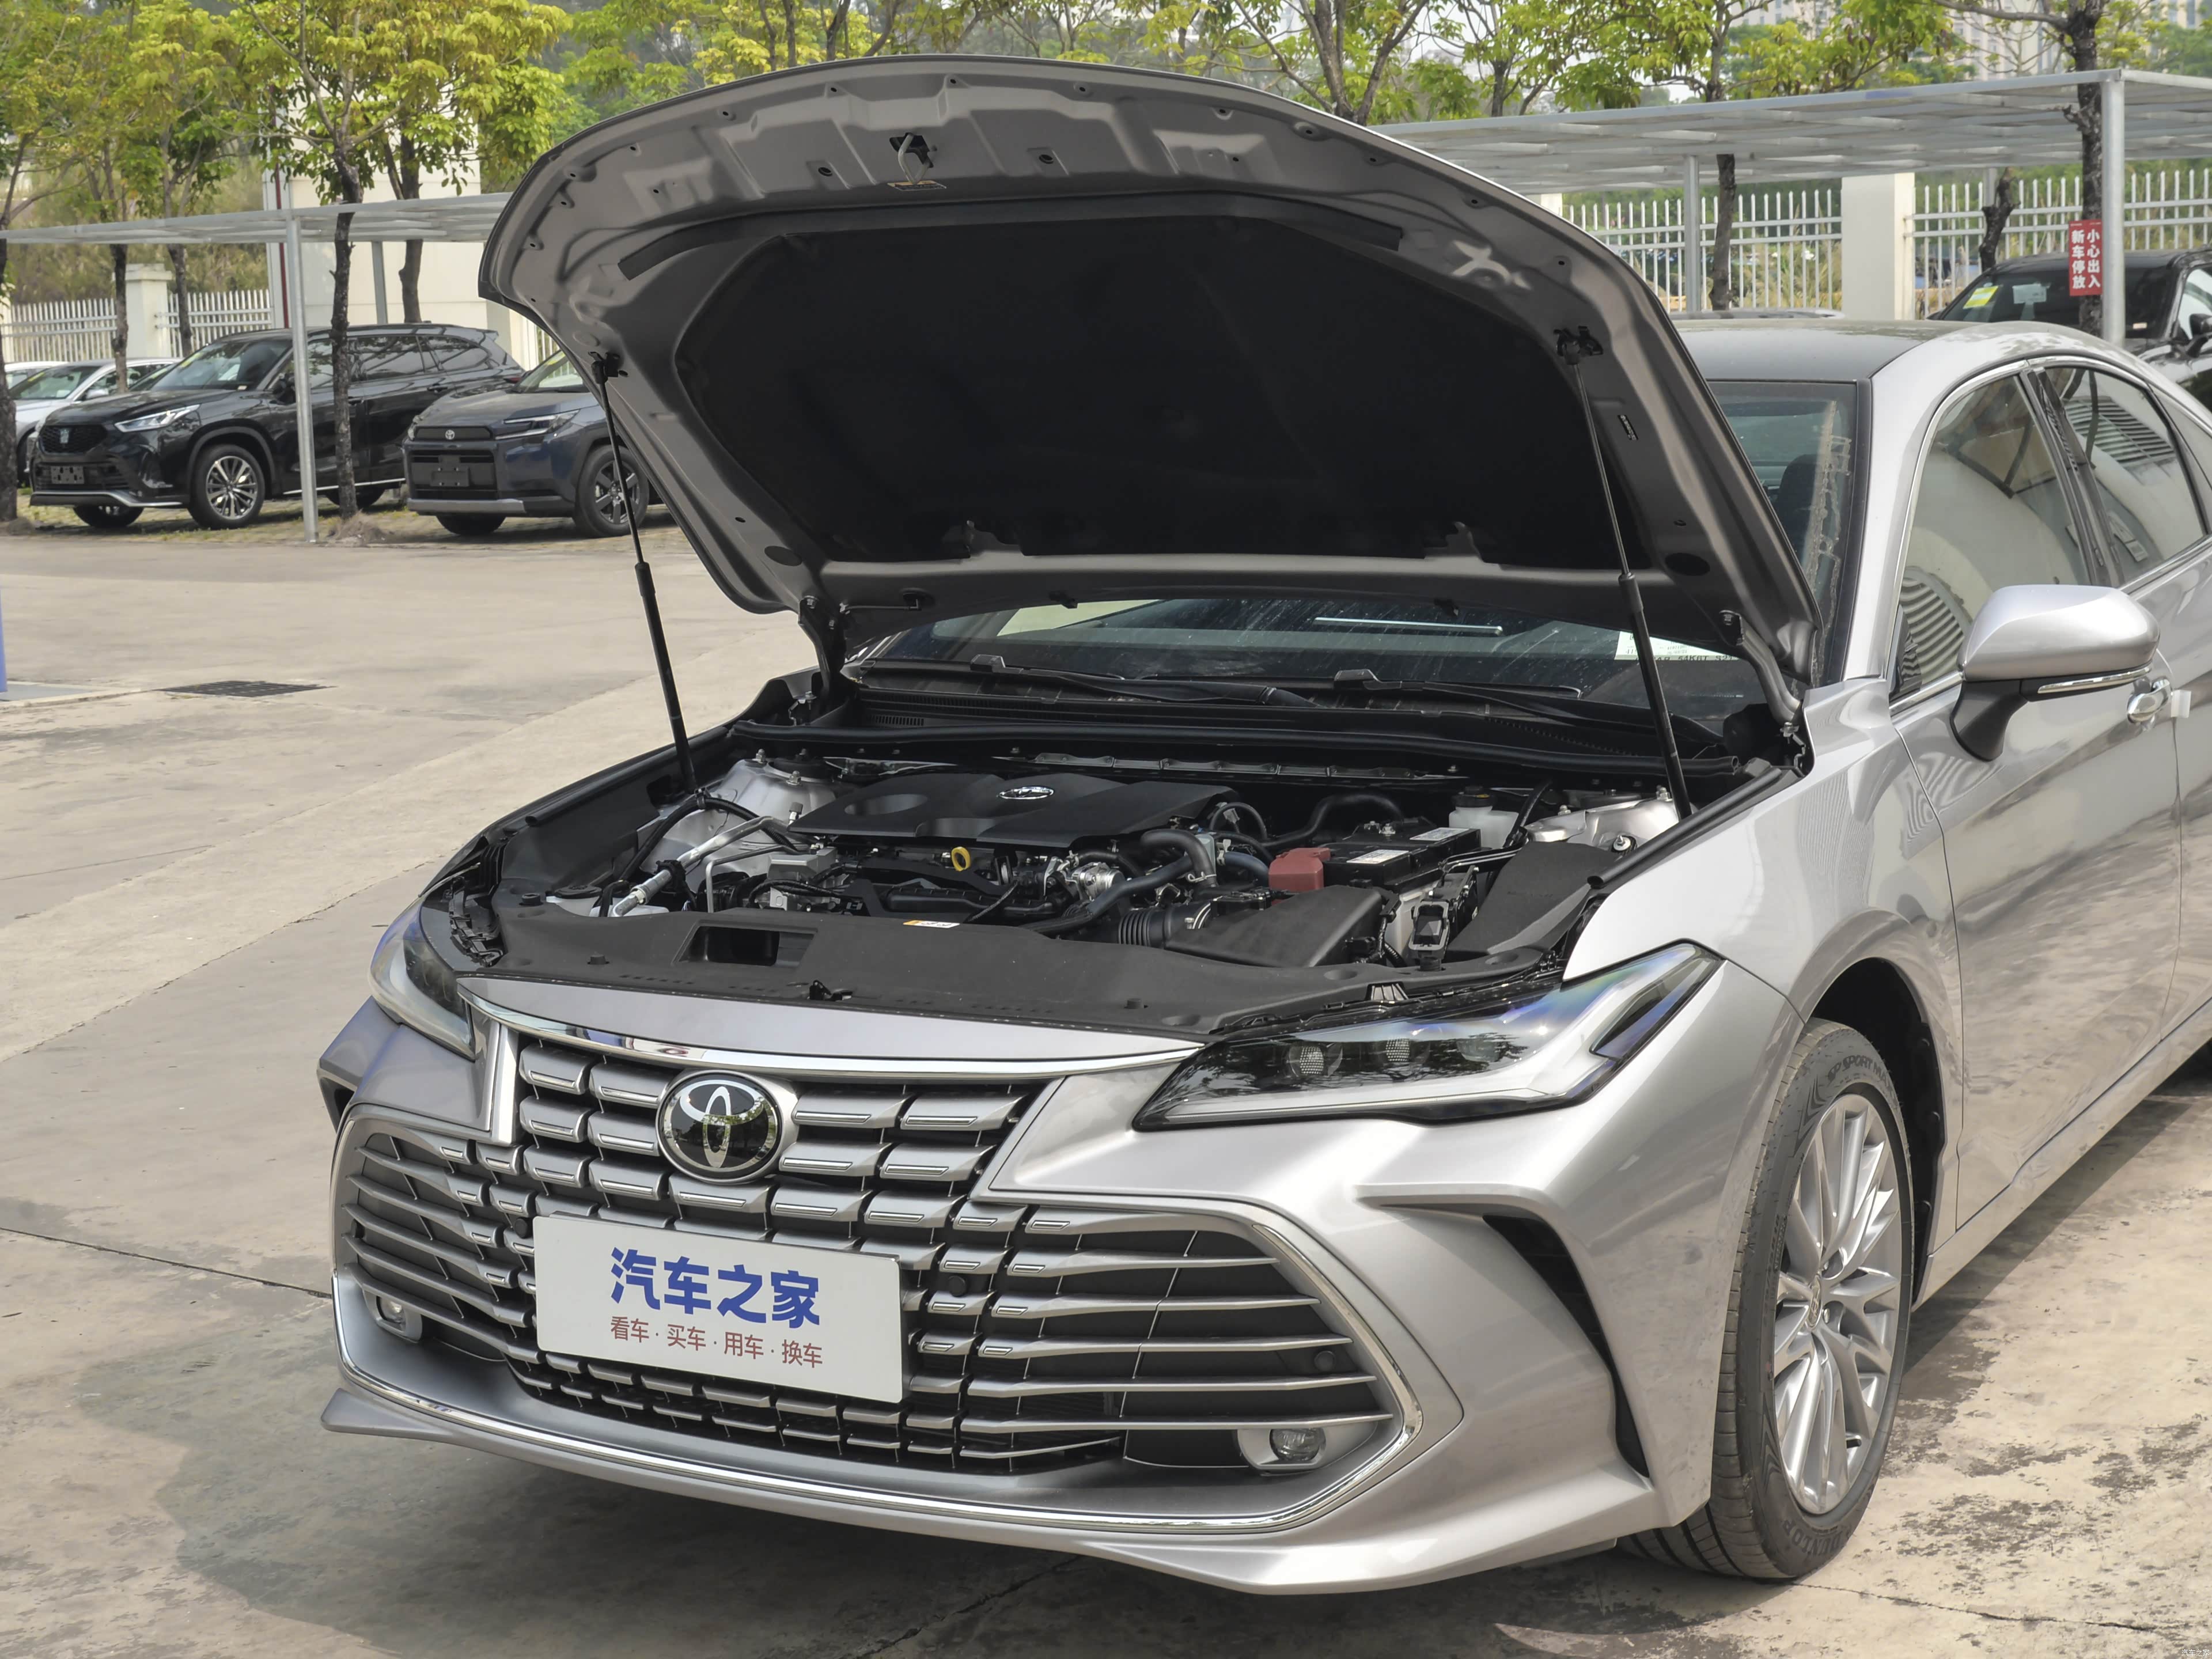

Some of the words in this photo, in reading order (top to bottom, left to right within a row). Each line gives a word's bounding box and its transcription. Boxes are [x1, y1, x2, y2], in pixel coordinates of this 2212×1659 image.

[2071, 230, 2085, 289] 新车停放
[2087, 229, 2100, 288] 小心出入
[1842, 1054, 1873, 1071] SPORT
[611, 1247, 820, 1328] 汽车之家
